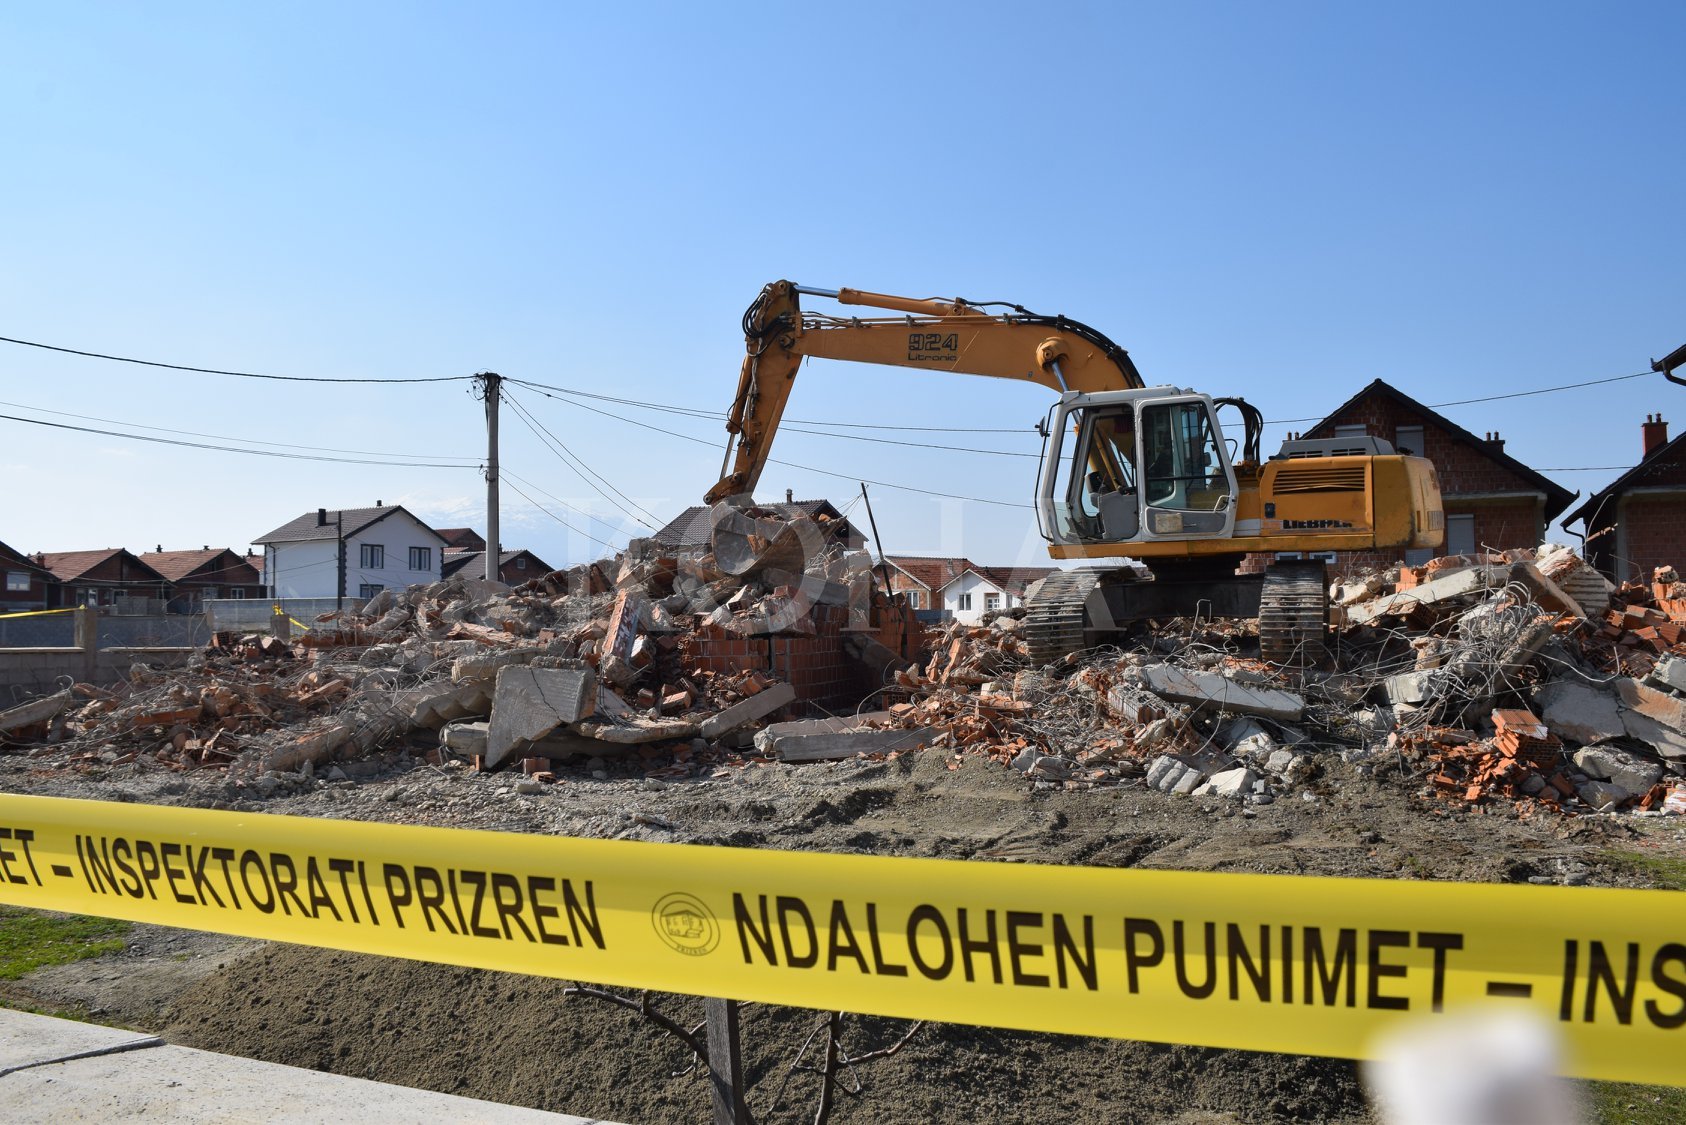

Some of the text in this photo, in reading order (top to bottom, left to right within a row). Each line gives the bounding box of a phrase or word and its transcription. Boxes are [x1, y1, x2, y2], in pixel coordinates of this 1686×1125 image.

[908, 333, 959, 351] 924
[908, 351, 957, 361] Litronic
[0, 827, 43, 887] ET
[75, 835, 381, 926] INSPEKTORATI
[383, 863, 607, 950] PRIZREN
[732, 892, 1098, 991] NDALOHEN
[1124, 917, 1464, 1013] PUNIMET
[1559, 939, 1686, 1030] INS
